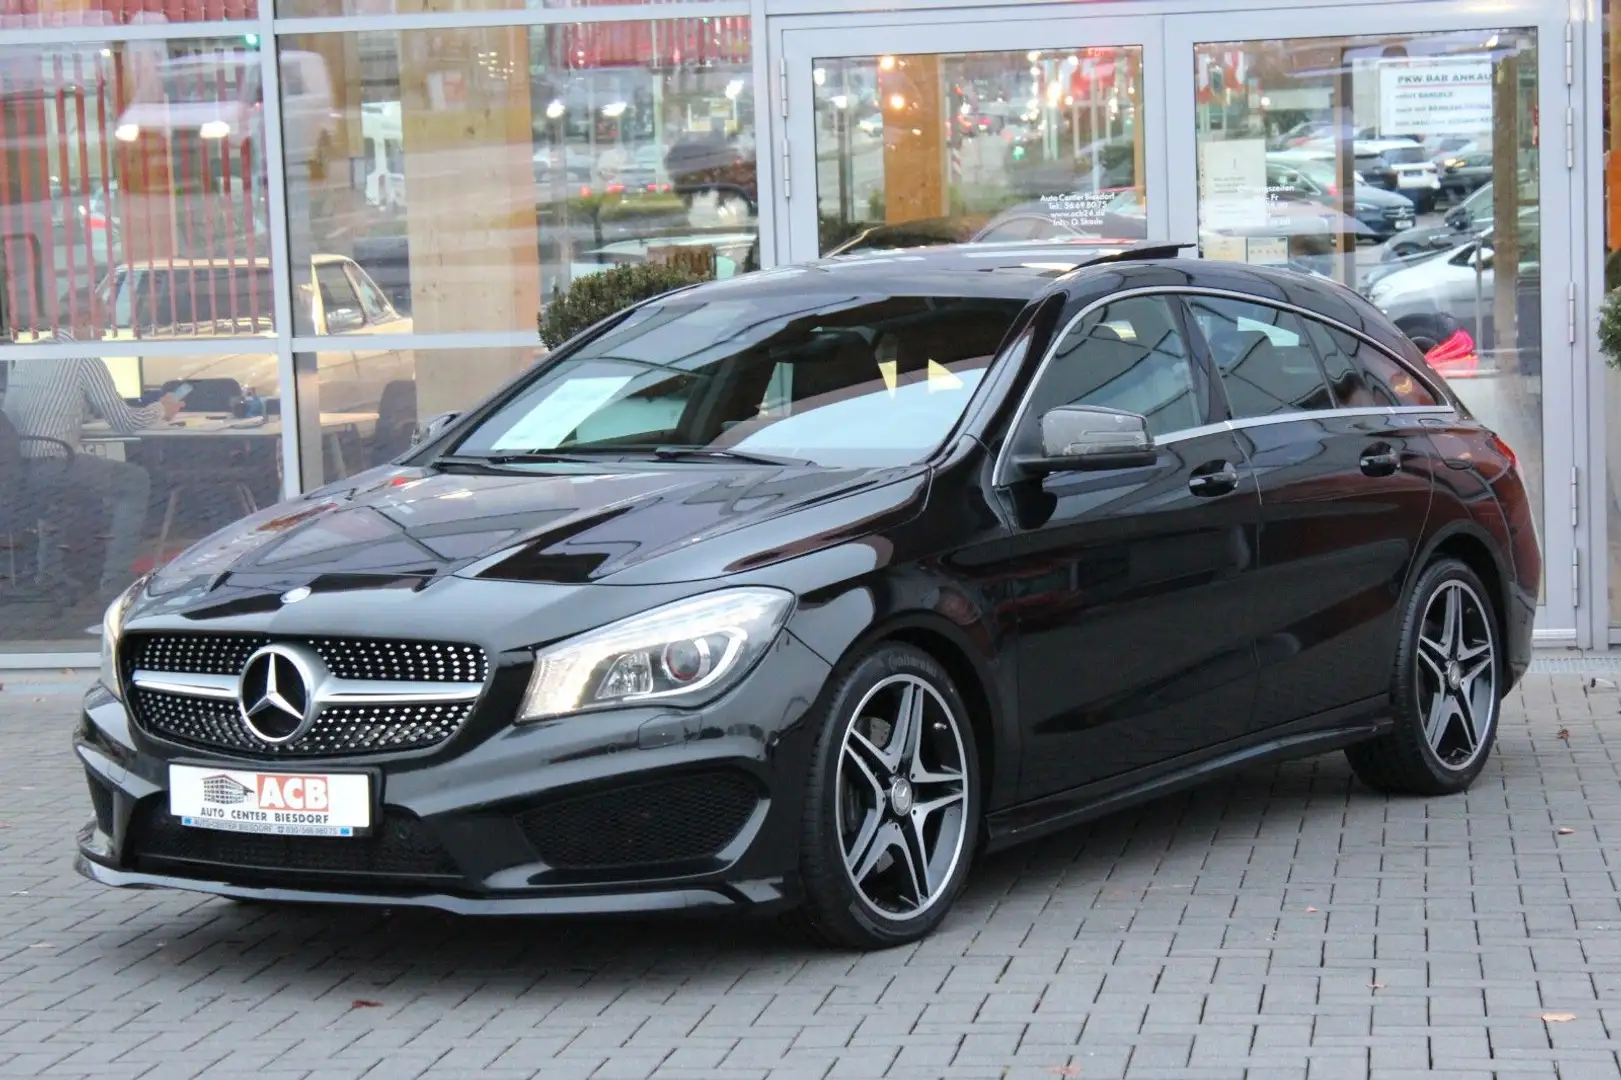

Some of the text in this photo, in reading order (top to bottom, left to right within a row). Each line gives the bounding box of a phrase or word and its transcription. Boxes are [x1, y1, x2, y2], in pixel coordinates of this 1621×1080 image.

[259, 777, 328, 810] ACB
[201, 807, 329, 824] AUTO CENTER BIESDORF
